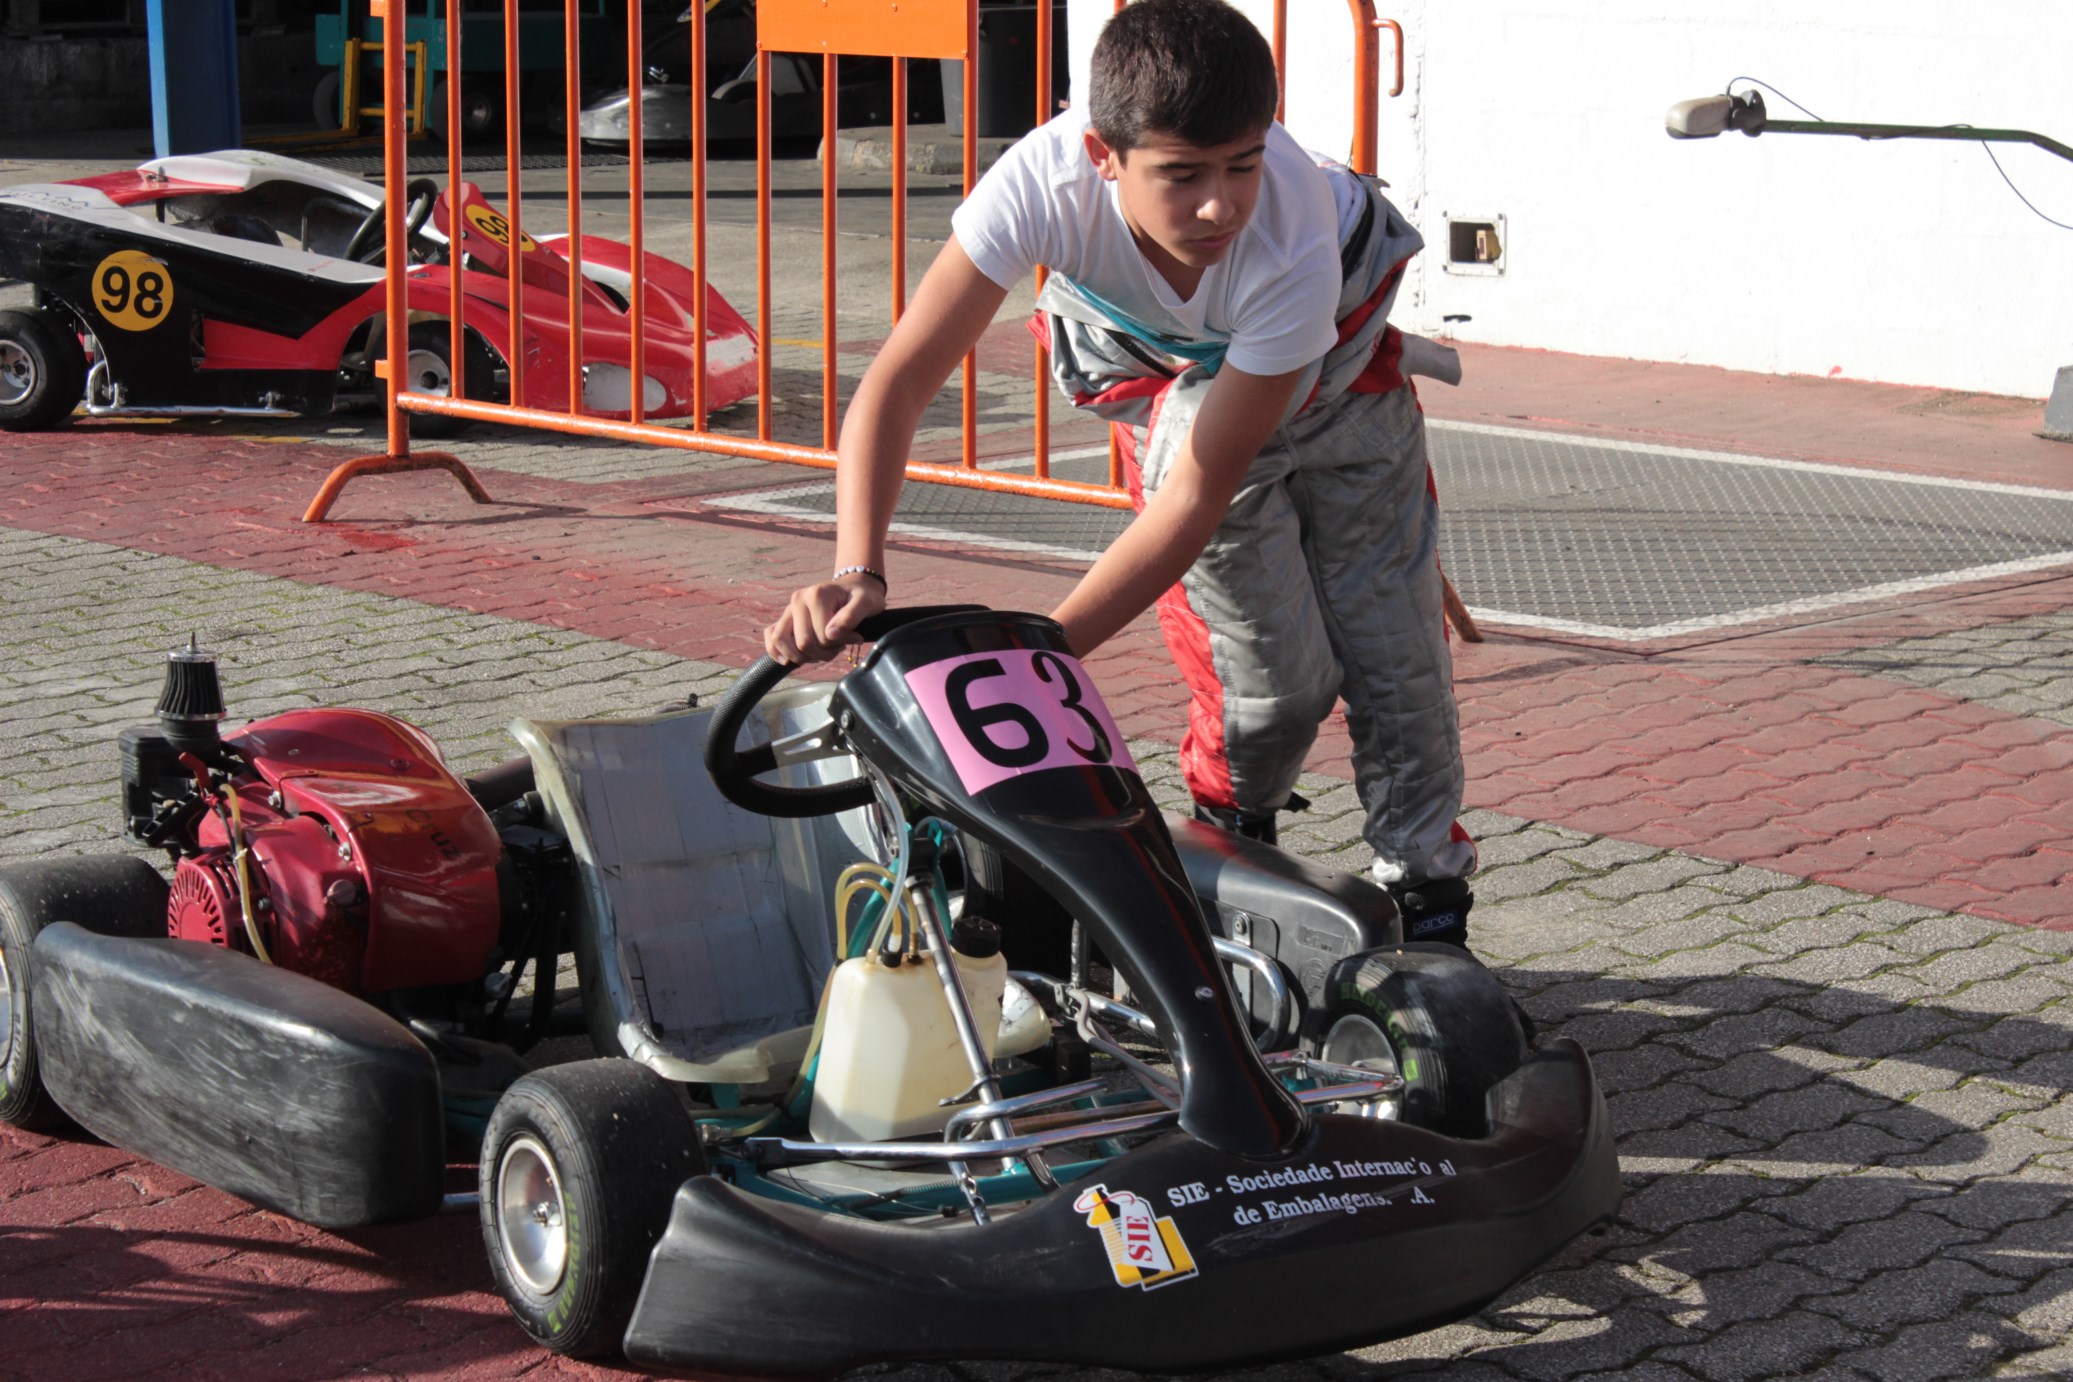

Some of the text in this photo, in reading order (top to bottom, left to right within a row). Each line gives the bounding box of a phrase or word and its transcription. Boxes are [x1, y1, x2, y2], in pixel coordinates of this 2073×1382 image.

[101, 266, 164, 319] 98
[945, 651, 1112, 768] 63
[1167, 1181, 1211, 1208] SIE
[1226, 1162, 1334, 1194] Sociedade
[1126, 1215, 1153, 1263] SIE
[1233, 1205, 1262, 1226] de
